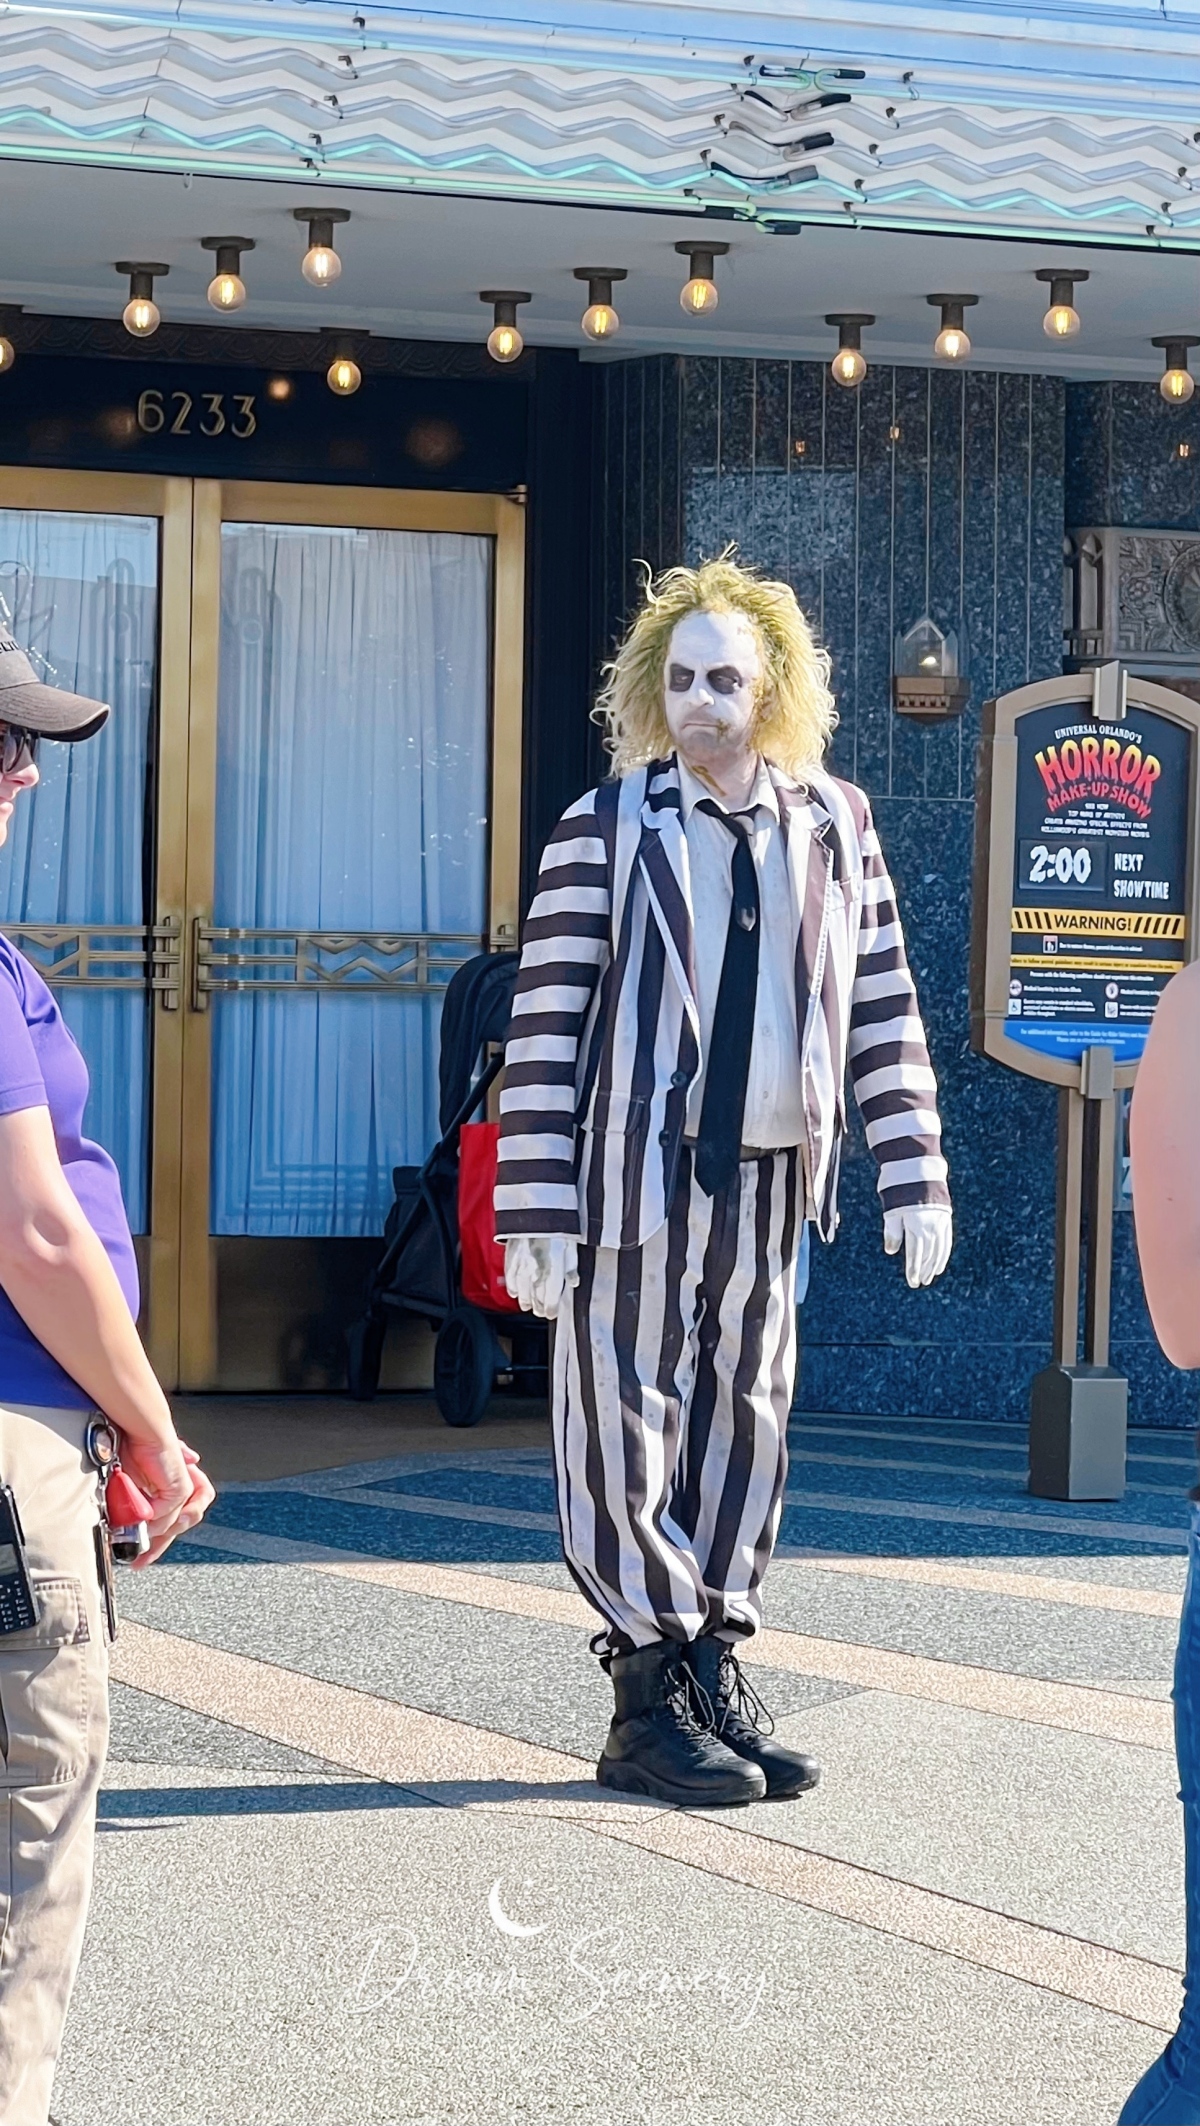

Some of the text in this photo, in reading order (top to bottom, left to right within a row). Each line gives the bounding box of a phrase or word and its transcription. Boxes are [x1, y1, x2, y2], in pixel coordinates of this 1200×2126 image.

[138, 389, 256, 438] 6233
[1055, 724, 1143, 744] UNIVERSAL ORLANDO'S
[1035, 736, 1161, 803] HORROR
[1047, 781, 1152, 819] MAKE-UP SHOW
[1029, 845, 1091, 884] 2:00
[1114, 853, 1143, 872] NEXT
[1113, 879, 1170, 900] SHOWTIME
[1054, 913, 1132, 931] WARNING!
